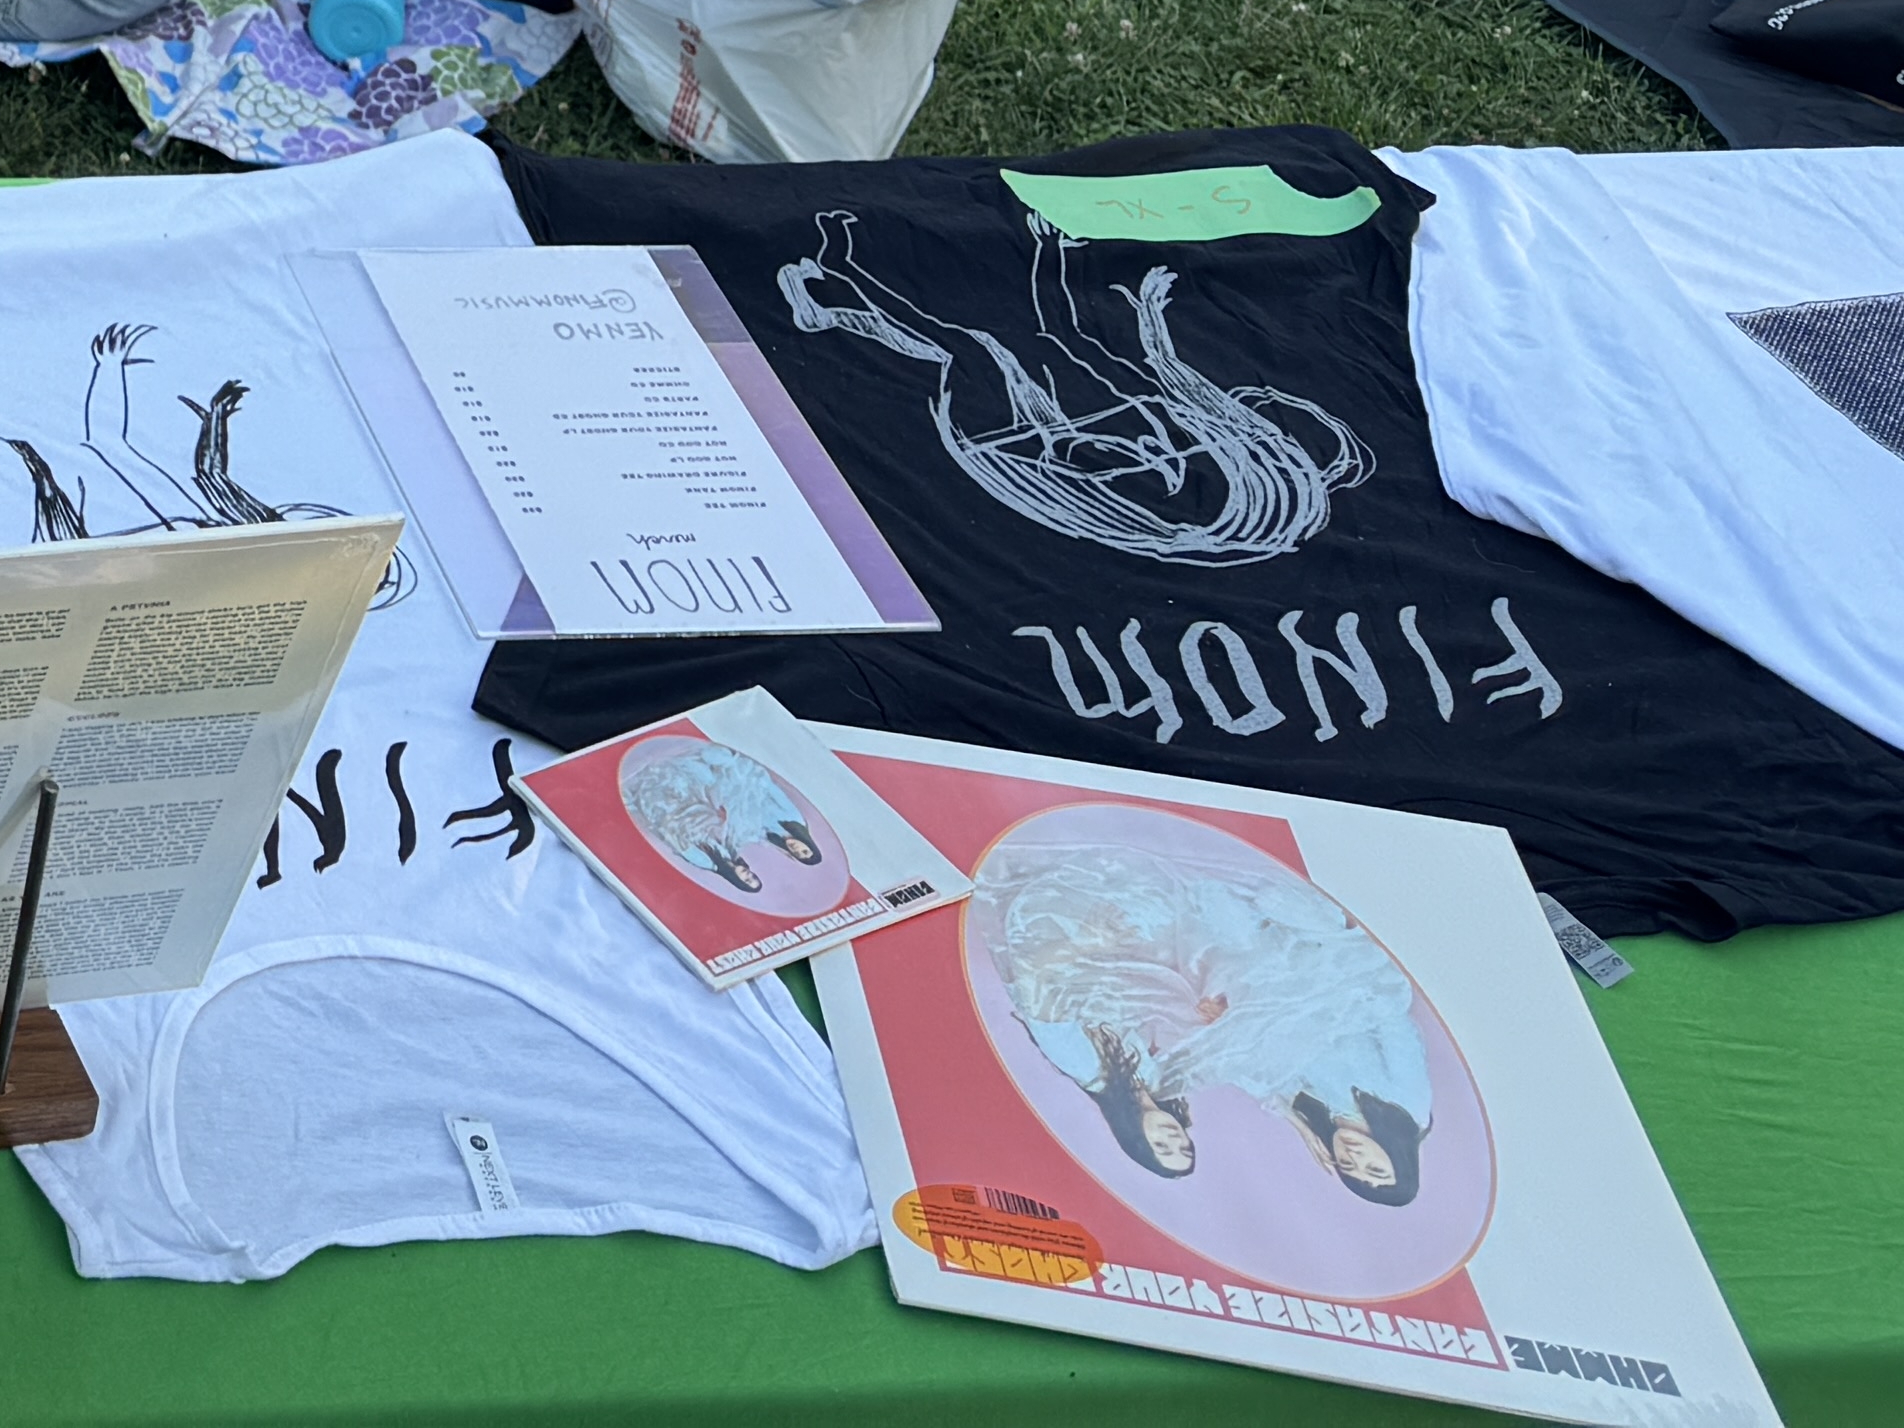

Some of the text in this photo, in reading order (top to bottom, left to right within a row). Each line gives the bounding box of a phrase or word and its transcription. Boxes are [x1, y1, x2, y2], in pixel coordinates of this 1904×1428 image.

[454, 289, 636, 312] @FINOMMUSIC
[553, 322, 663, 340] VENMO
[620, 426, 651, 434] YOUR
[655, 425, 717, 433] FANTASIZE
[627, 533, 696, 550] merch
[590, 557, 792, 614] FINOM
[1011, 597, 1563, 745] FINOM
[1095, 1264, 1219, 1314] YOUR
[1217, 1282, 1491, 1365] FANTASIZE
[1503, 1336, 1683, 1399] OHMME
